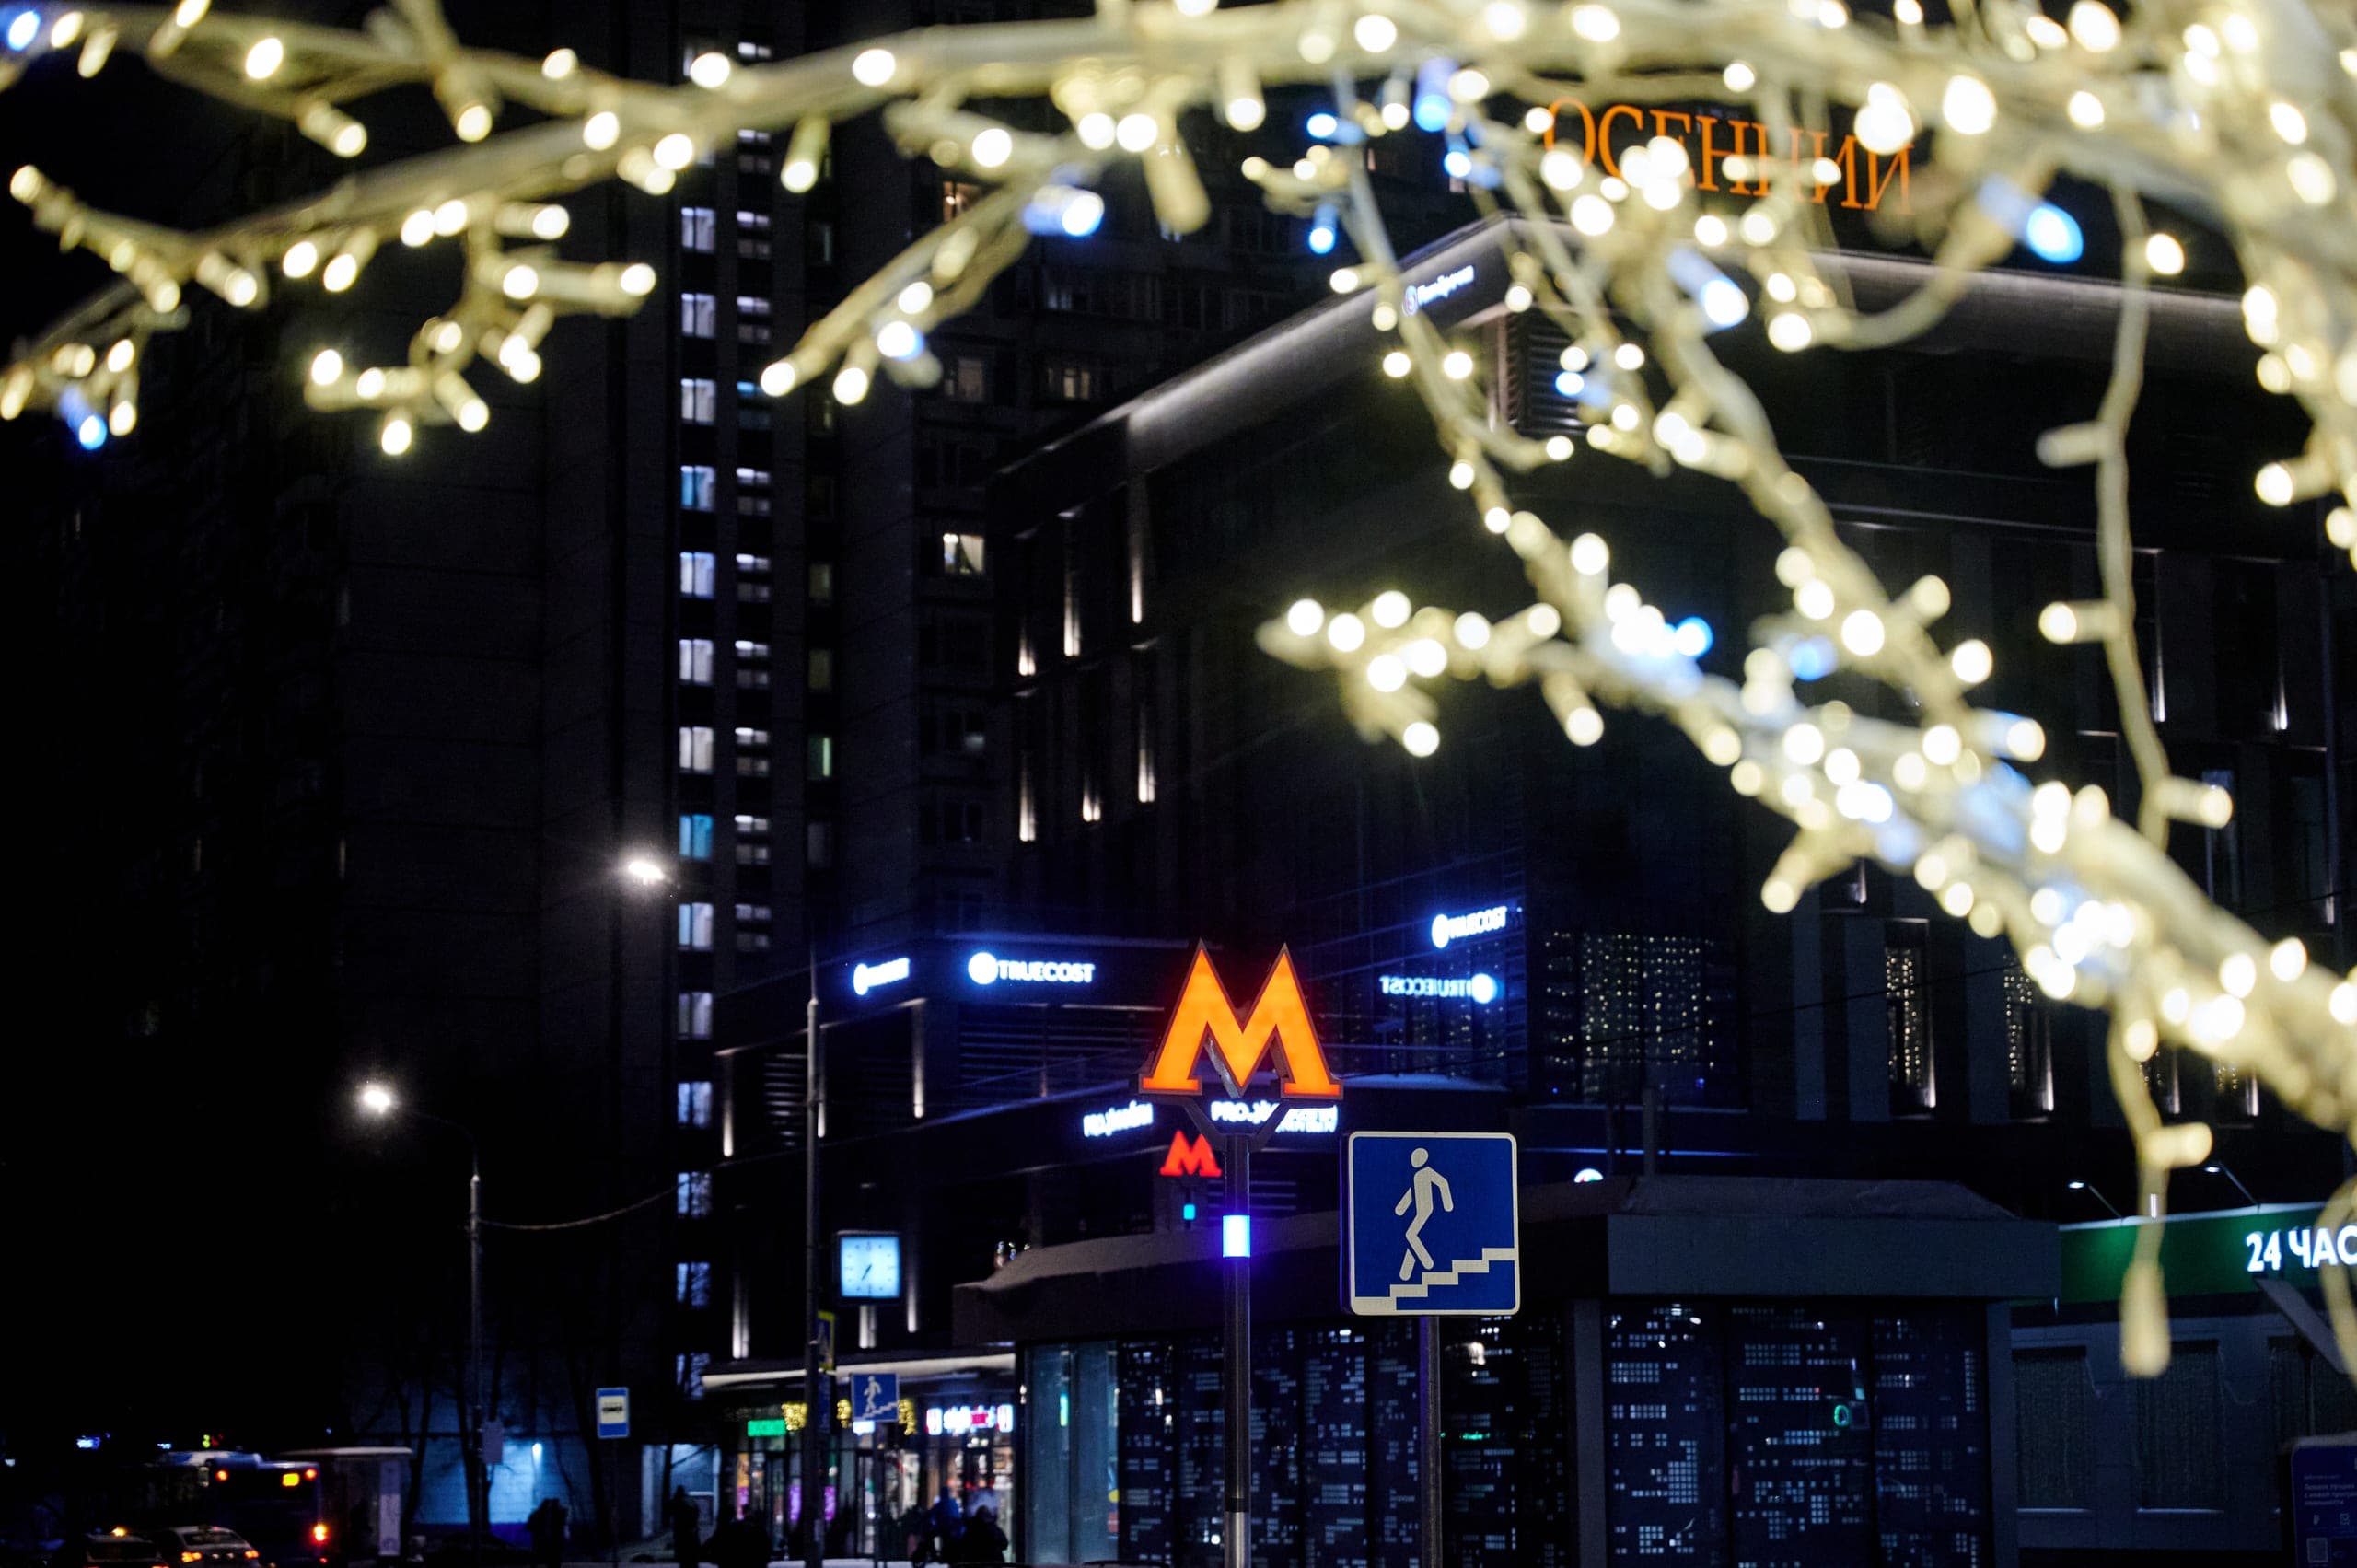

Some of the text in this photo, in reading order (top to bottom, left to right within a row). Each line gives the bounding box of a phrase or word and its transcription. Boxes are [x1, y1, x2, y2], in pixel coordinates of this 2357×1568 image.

[997, 959, 1096, 982] TRUECOST
[1141, 942, 1341, 1097] М
[1160, 1130, 1222, 1177] М
[2246, 1224, 2357, 1272] 24 ЧАС
